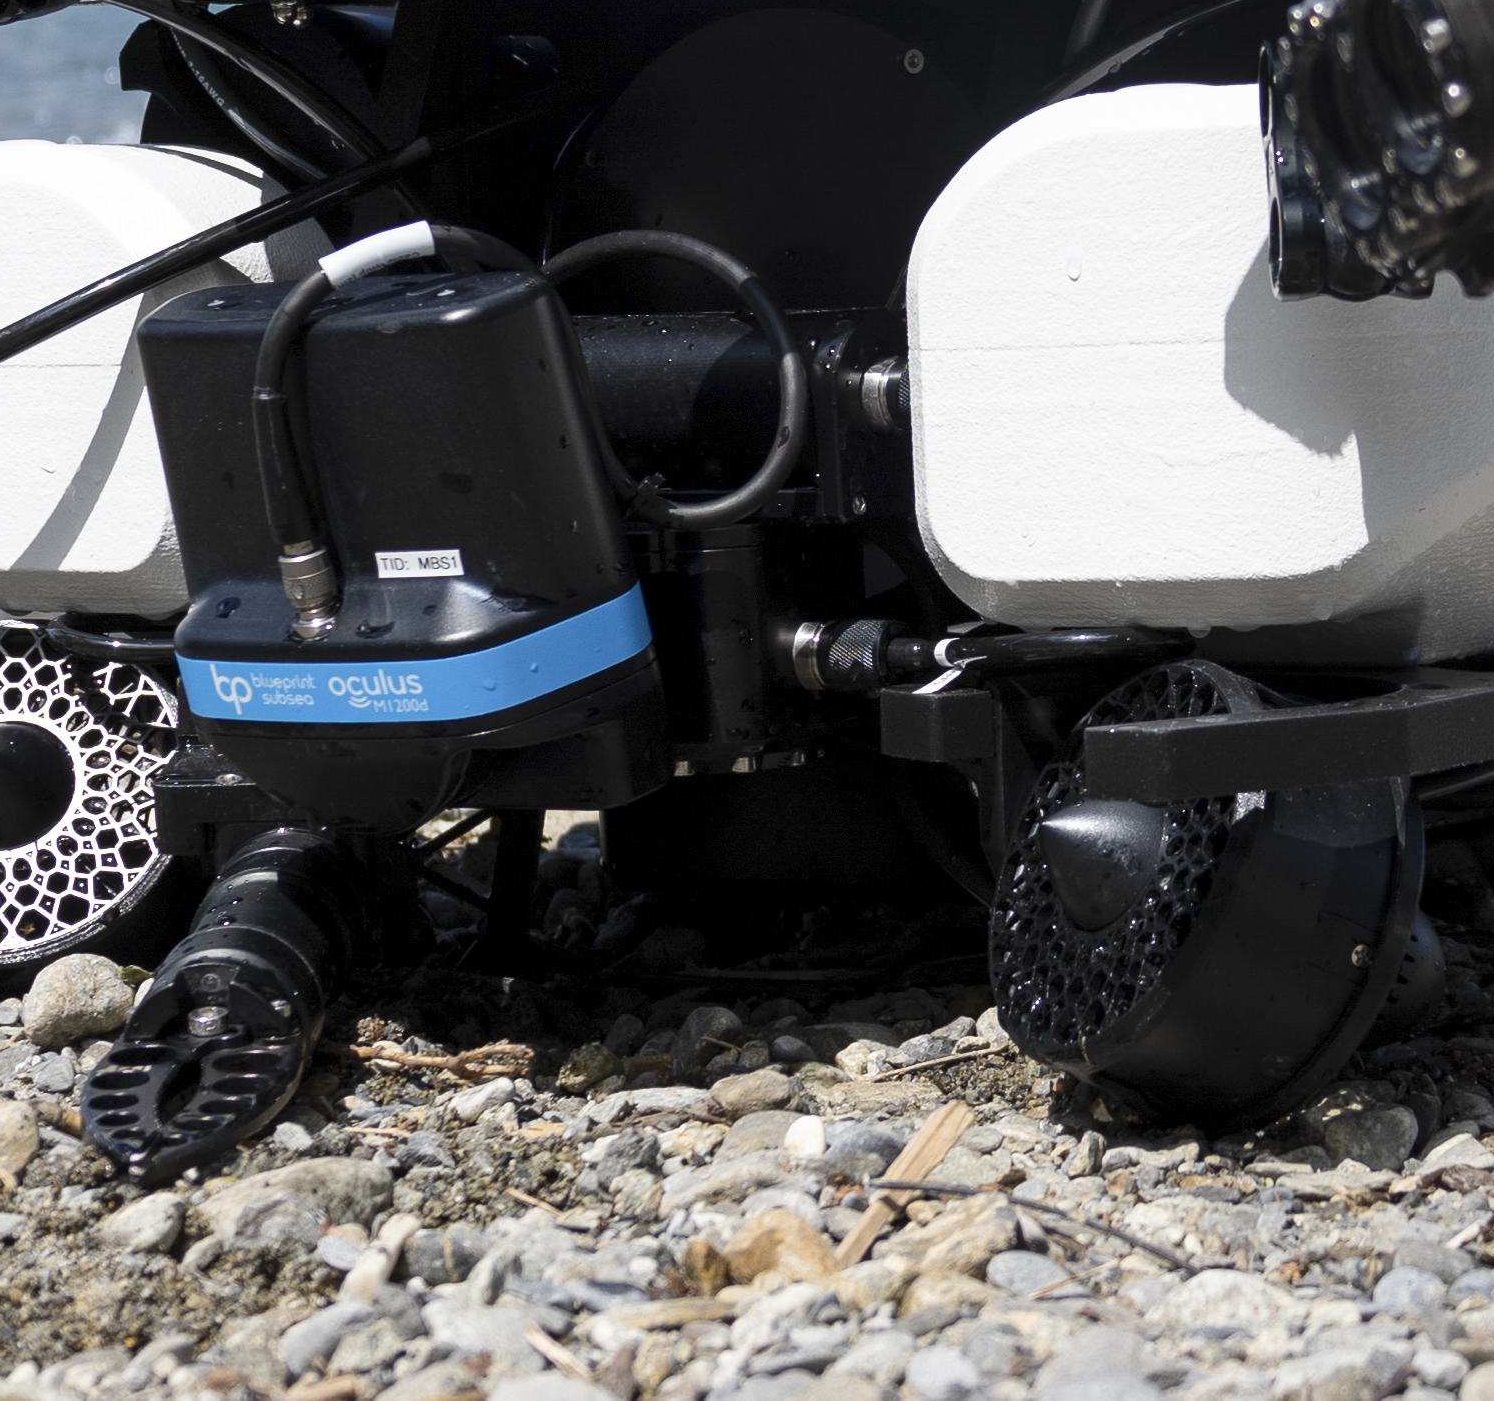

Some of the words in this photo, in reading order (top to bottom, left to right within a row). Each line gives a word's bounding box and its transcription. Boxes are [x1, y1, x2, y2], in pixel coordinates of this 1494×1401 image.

[380, 557, 410, 570] TID:
[417, 556, 458, 570] MBS1
[249, 673, 317, 693] blueprint
[328, 668, 423, 696] oculus
[262, 690, 315, 706] subsea
[372, 698, 429, 713] M1200d
